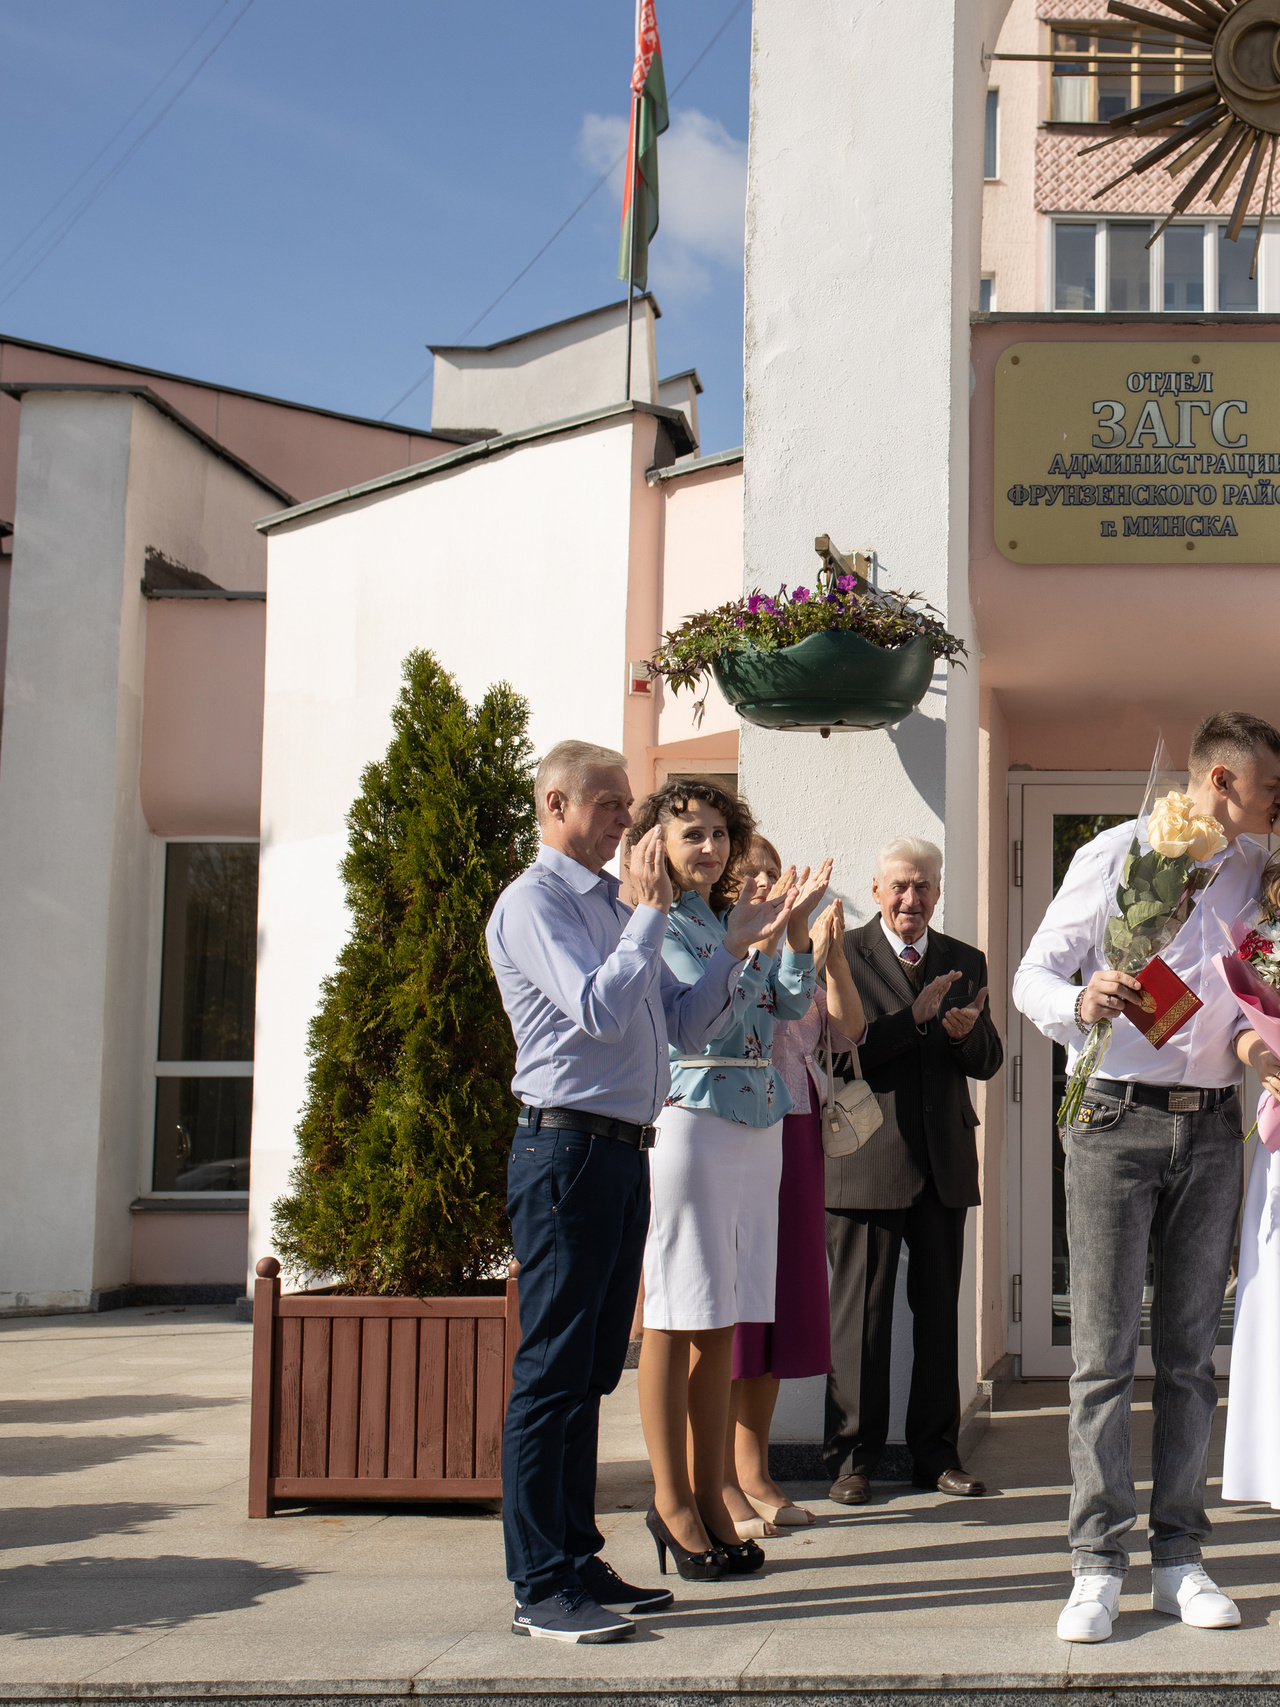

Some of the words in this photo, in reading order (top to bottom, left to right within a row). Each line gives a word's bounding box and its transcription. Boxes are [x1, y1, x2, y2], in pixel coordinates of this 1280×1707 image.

[1126, 372, 1214, 396] ОТДЕЛ
[1091, 400, 1248, 448] ЗАГС
[1007, 483, 1217, 506] ФРУНЗЕНСКОГО
[1100, 520, 1117, 537] г.
[1122, 515, 1238, 537] МИНСКА
